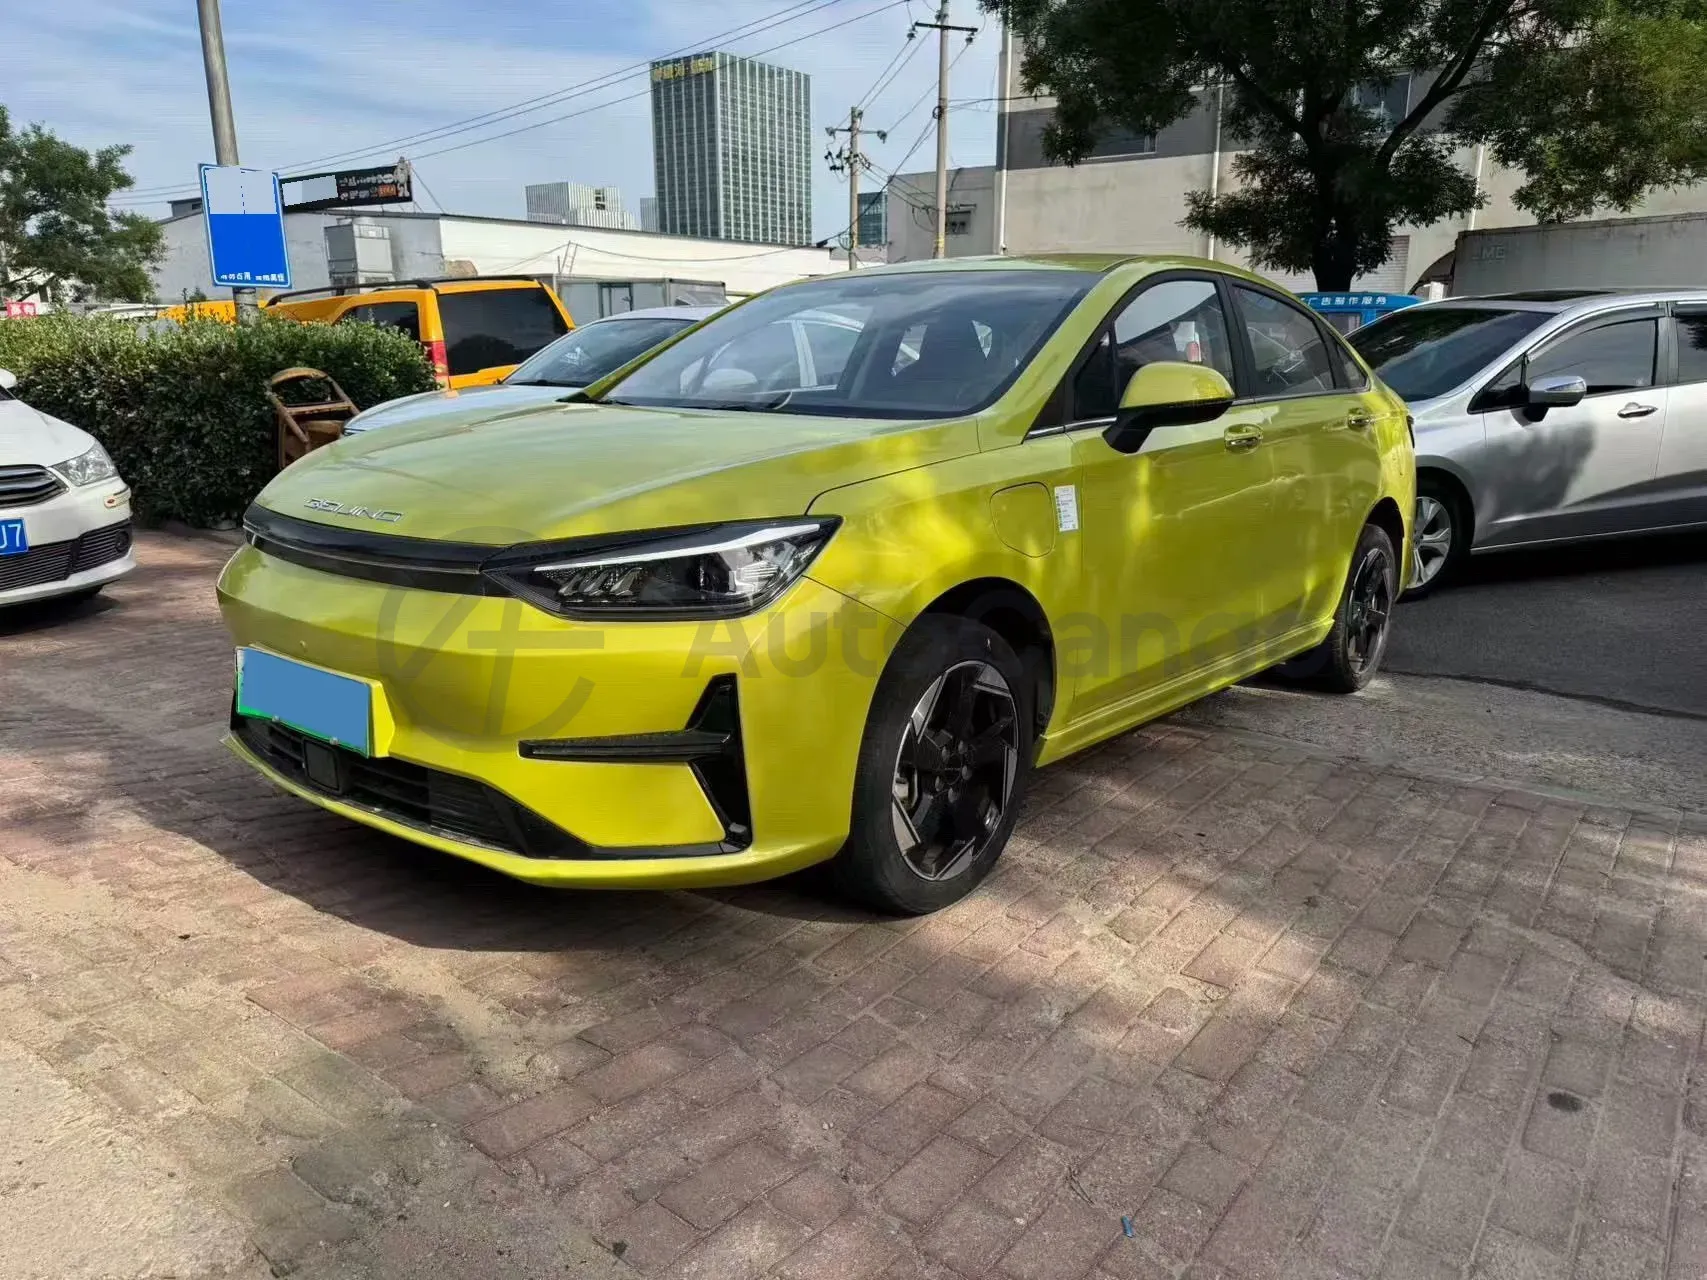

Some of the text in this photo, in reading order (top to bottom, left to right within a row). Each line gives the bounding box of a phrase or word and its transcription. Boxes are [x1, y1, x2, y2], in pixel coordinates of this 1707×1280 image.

[1301, 295, 1387, 306] 广告制作服务
